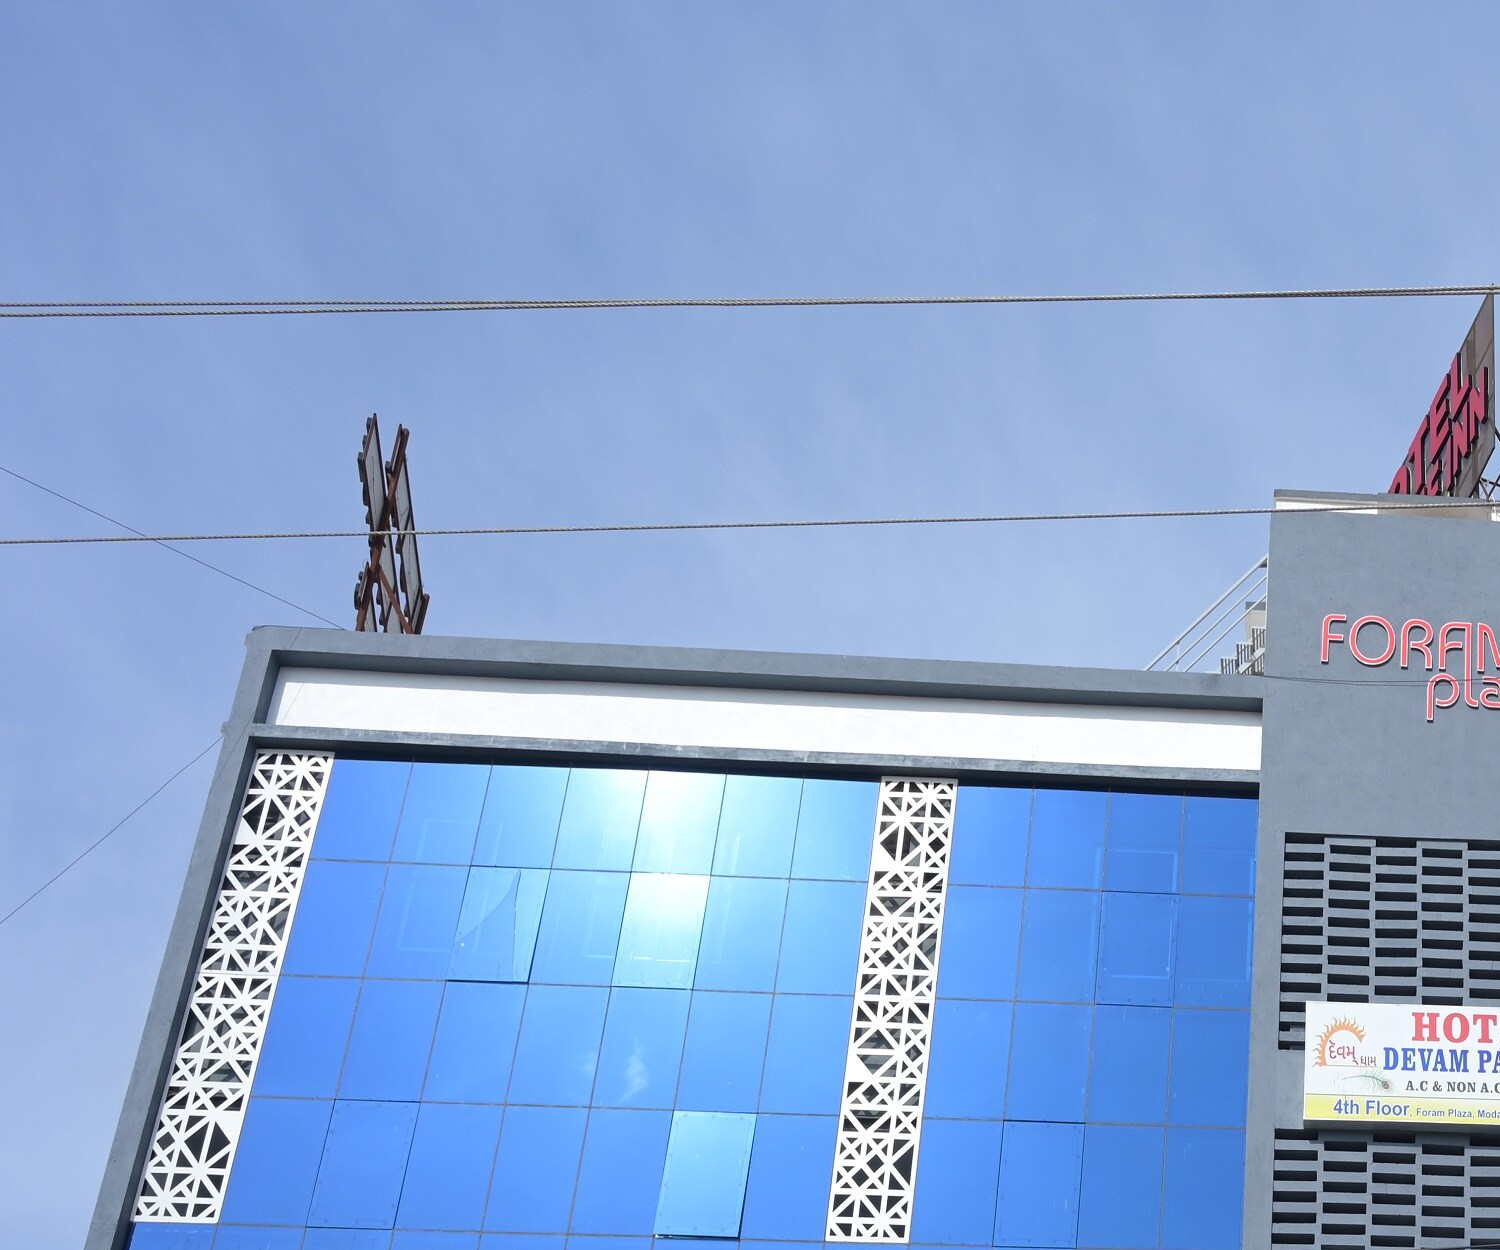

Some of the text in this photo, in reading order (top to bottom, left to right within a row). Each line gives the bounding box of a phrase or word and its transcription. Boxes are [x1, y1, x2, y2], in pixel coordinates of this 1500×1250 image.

[1383, 1047, 1468, 1073] DEVAM
[1405, 1080, 1428, 1092] A.C
[1432, 1081, 1443, 1092] &
[1447, 1081, 1476, 1093] NON
[1333, 1098, 1359, 1116] 4th
[1365, 1098, 1413, 1117] Floor,
[1416, 1106, 1445, 1118] Foram
[1448, 1107, 1475, 1119] Plaza,
